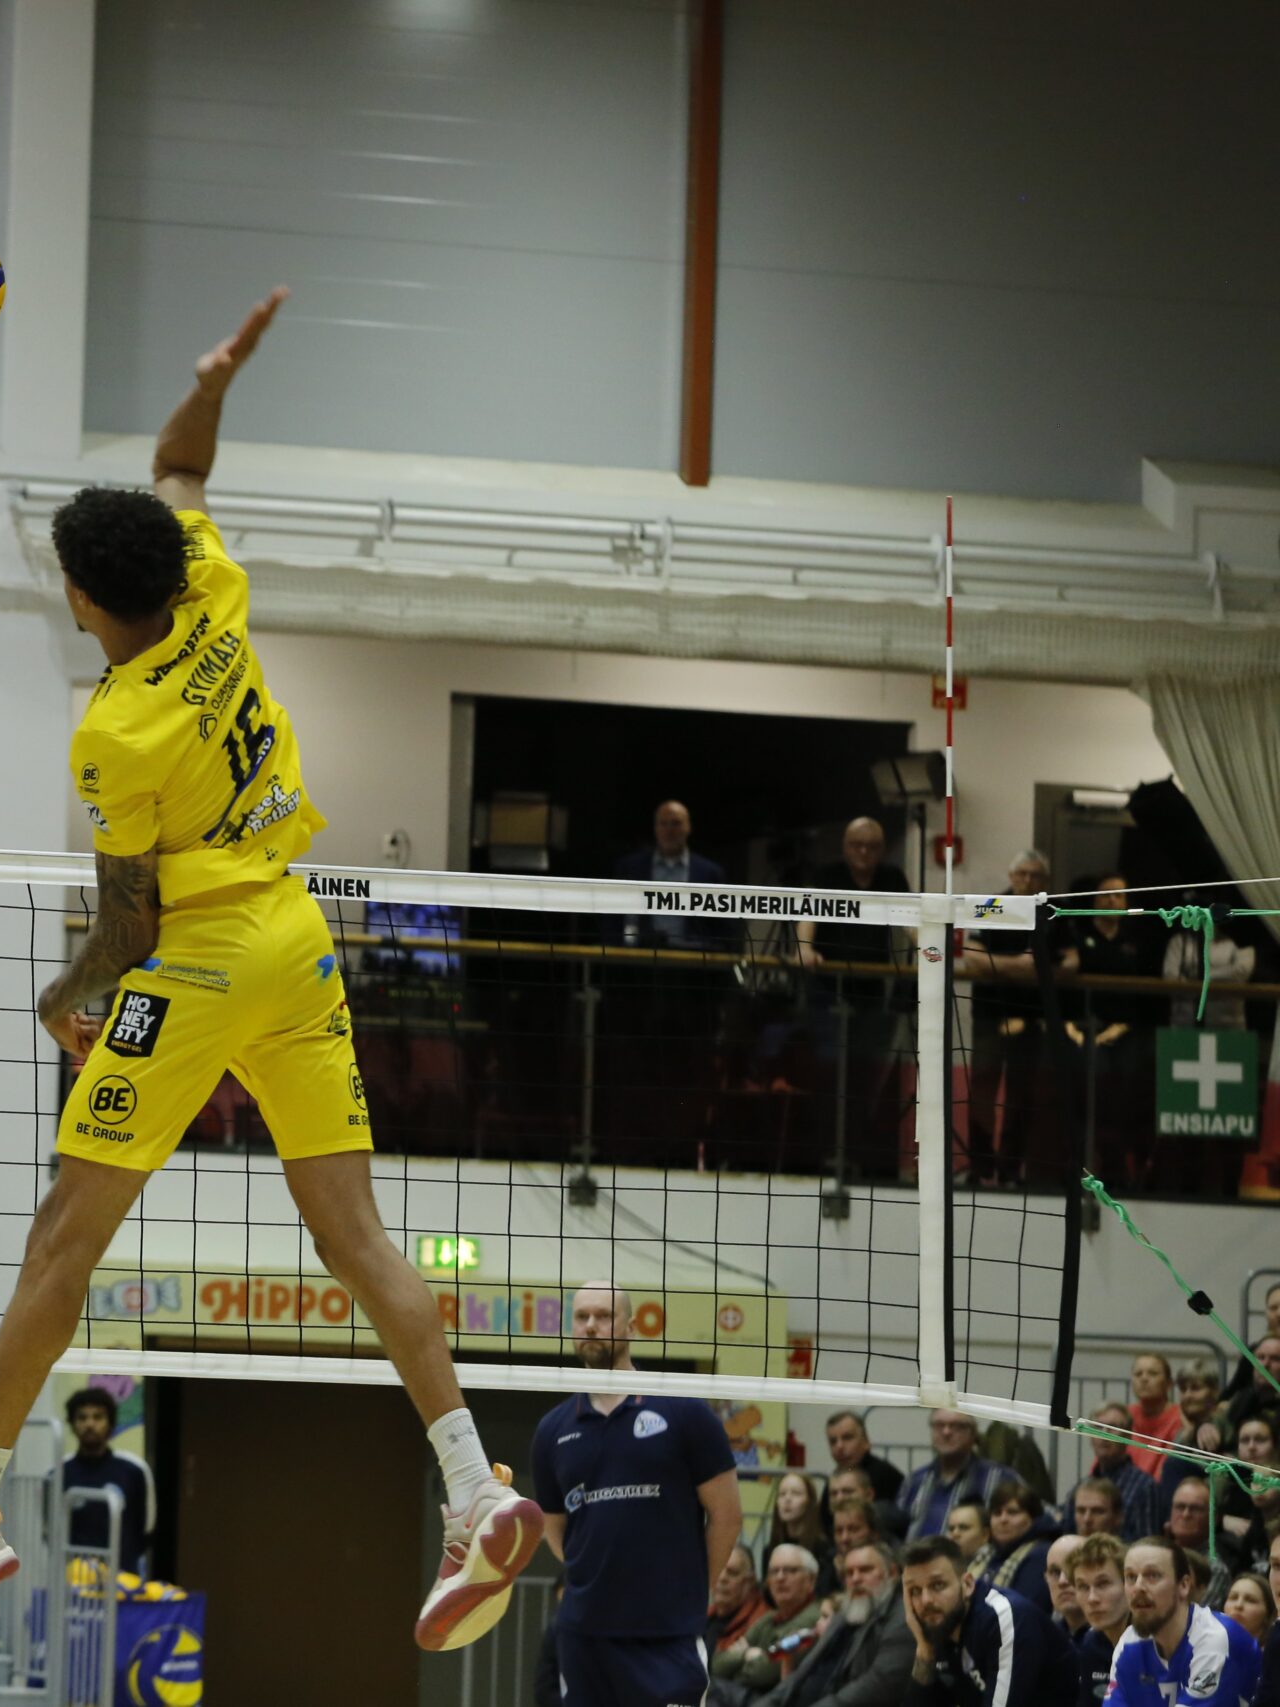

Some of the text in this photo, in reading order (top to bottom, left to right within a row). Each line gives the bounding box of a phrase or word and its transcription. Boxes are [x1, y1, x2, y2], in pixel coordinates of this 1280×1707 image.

[644, 891, 860, 918] TMI. PASI MERILÄINEN
[125, 995, 151, 1013] HO
[120, 1010, 156, 1030] NEY
[114, 1024, 149, 1044] STY
[93, 1087, 131, 1112] BE
[76, 1122, 134, 1143] BE GROUP
[1160, 1112, 1254, 1136] ENSIAPU
